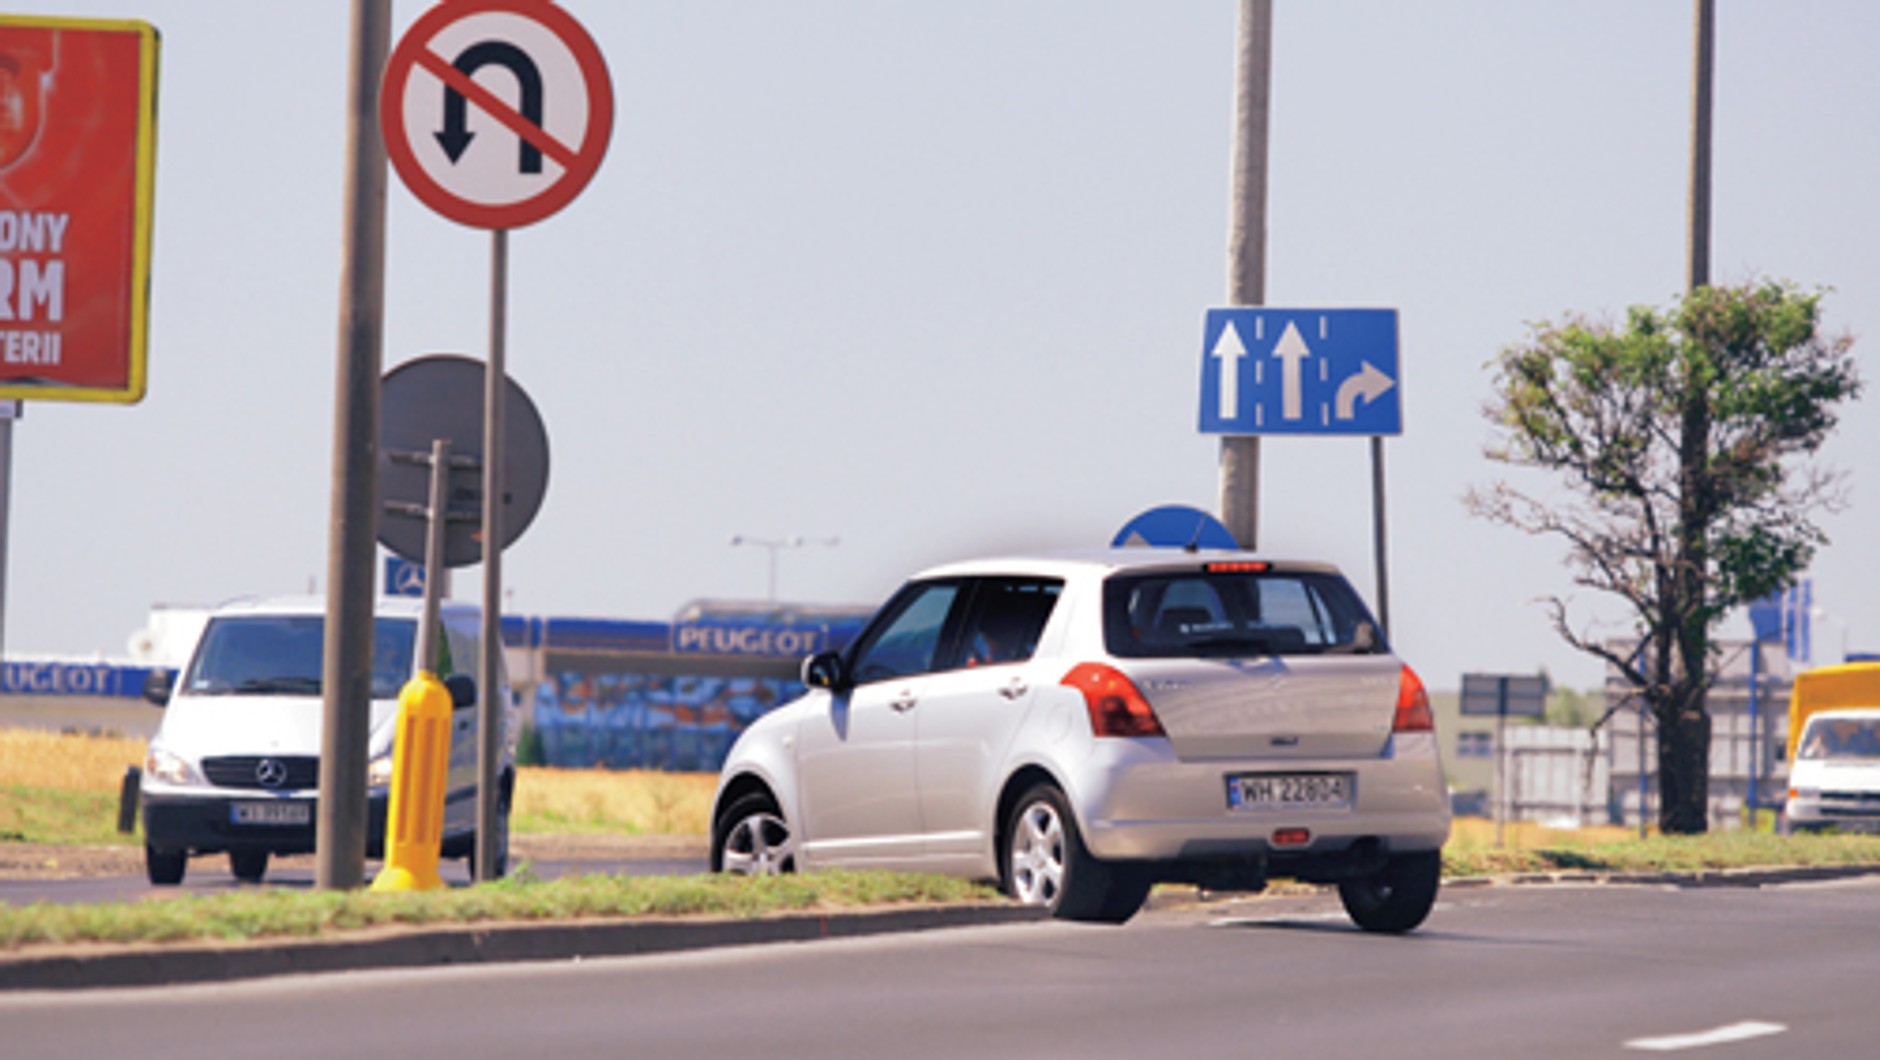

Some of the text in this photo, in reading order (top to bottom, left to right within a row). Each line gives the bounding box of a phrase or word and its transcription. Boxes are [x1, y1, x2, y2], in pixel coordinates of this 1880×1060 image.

[0, 211, 69, 252] ONY
[0, 331, 61, 365] ERII
[679, 626, 817, 654] PEUGEOT
[1241, 779, 1273, 802] WH
